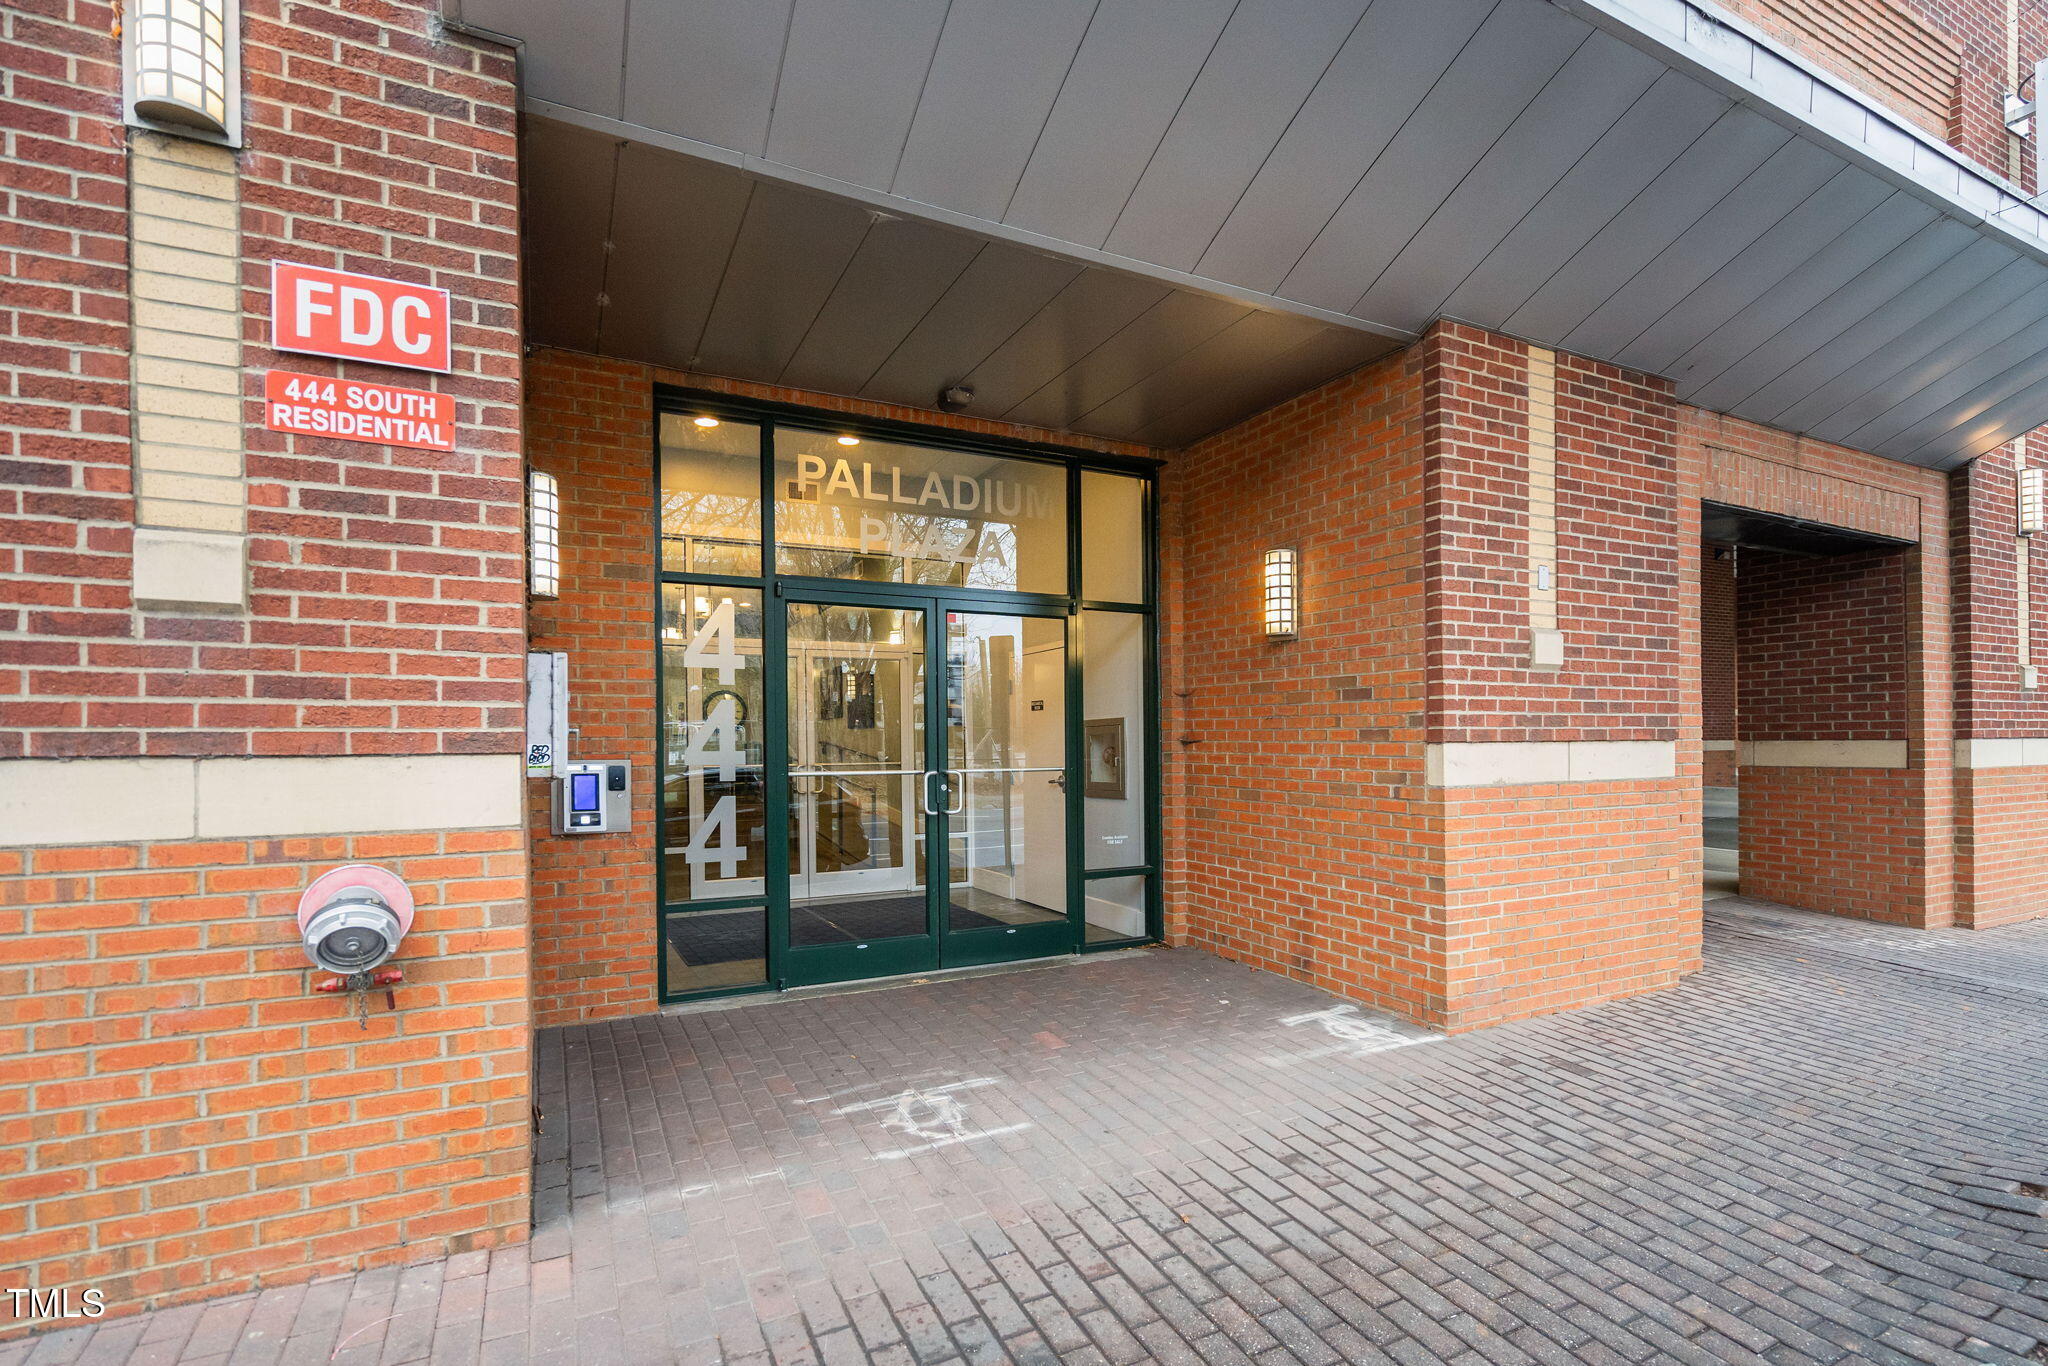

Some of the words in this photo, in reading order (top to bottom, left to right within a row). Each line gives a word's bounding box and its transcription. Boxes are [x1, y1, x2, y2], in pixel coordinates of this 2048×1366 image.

[295, 278, 432, 355] FDC
[272, 402, 449, 447] RESIDENTIAL
[284, 378, 337, 406] 444
[346, 386, 437, 419] SOUTH
[797, 453, 1053, 519] PALLADIUM
[859, 516, 1008, 568] PLAZA
